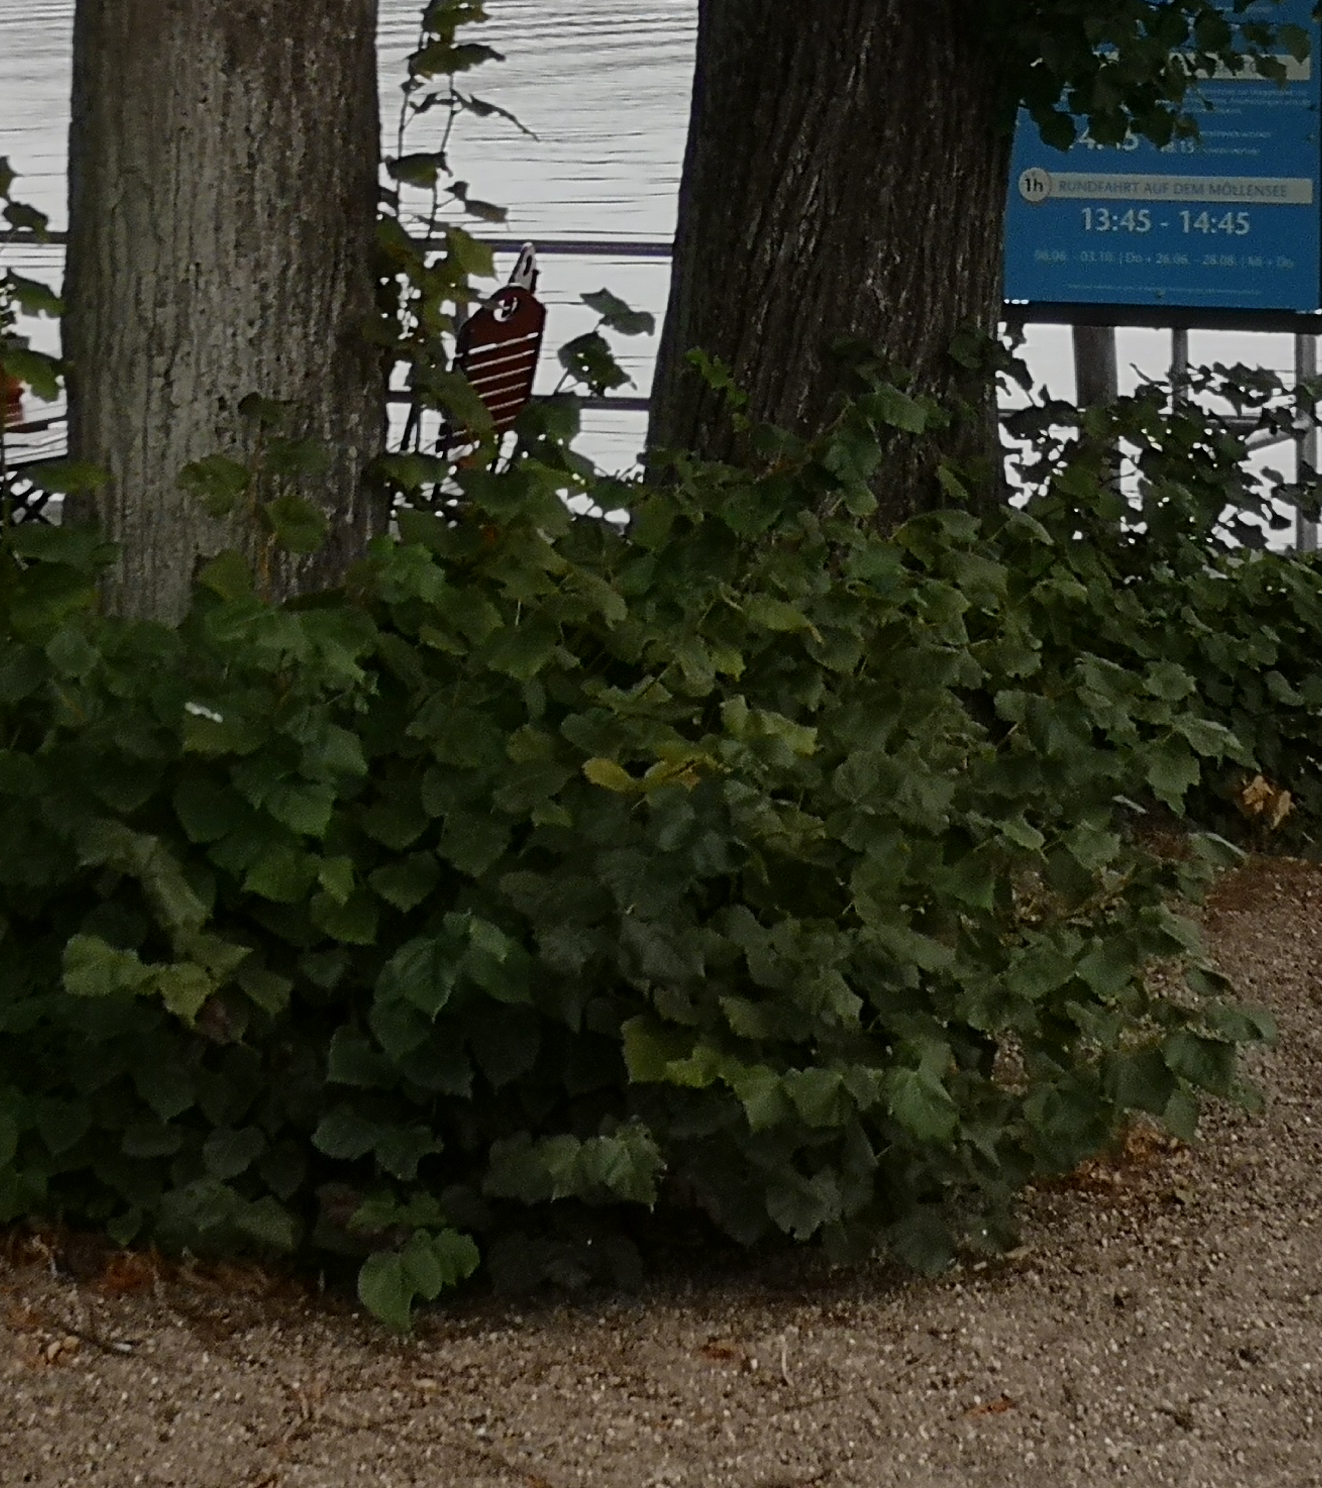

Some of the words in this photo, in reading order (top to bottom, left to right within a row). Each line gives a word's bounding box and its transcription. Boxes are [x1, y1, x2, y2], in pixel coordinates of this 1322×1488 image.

[1024, 177, 1044, 193] 1h
[1058, 179, 1140, 194] RUNDFAHRT
[1143, 181, 1169, 195] AUF
[1174, 182, 1205, 196] DEM
[1208, 180, 1287, 198] MÖLLENSEE
[1080, 206, 1152, 233] 13:45
[1179, 210, 1252, 235] 14:45
